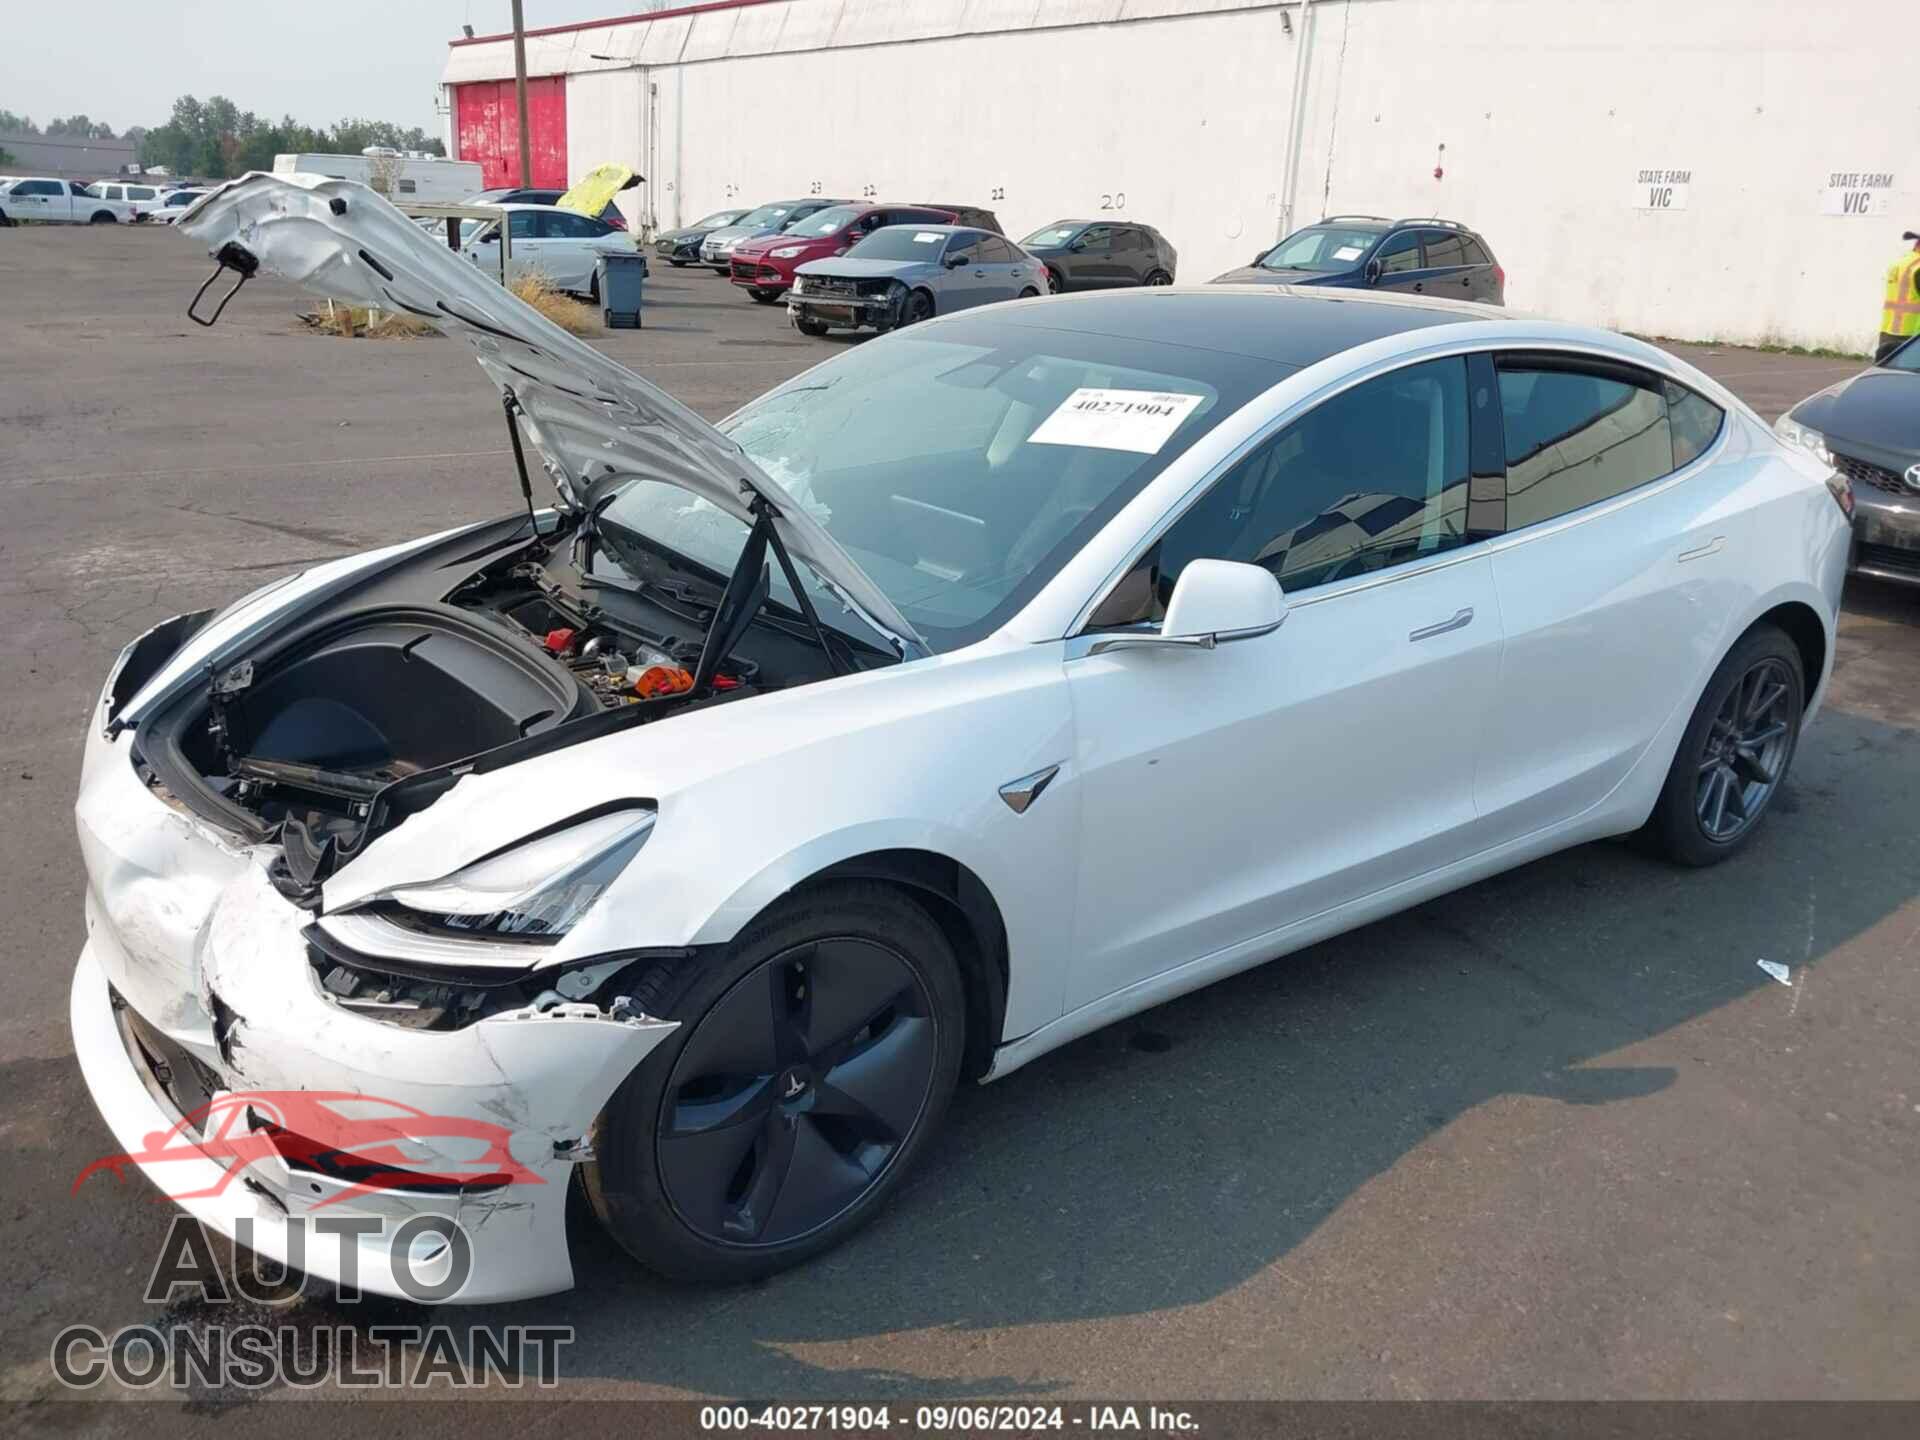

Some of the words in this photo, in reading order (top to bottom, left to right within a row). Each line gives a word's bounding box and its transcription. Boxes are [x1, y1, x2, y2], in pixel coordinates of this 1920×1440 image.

[1638, 170, 1663, 184] STATE
[1664, 170, 1691, 184] FARM
[1828, 173, 1859, 188] STATE
[1861, 173, 1894, 188] FARM
[1101, 193, 1126, 210] 20
[1650, 187, 1672, 207] VIC
[1843, 191, 1870, 213] VIC
[1072, 399, 1175, 417] 40271904
